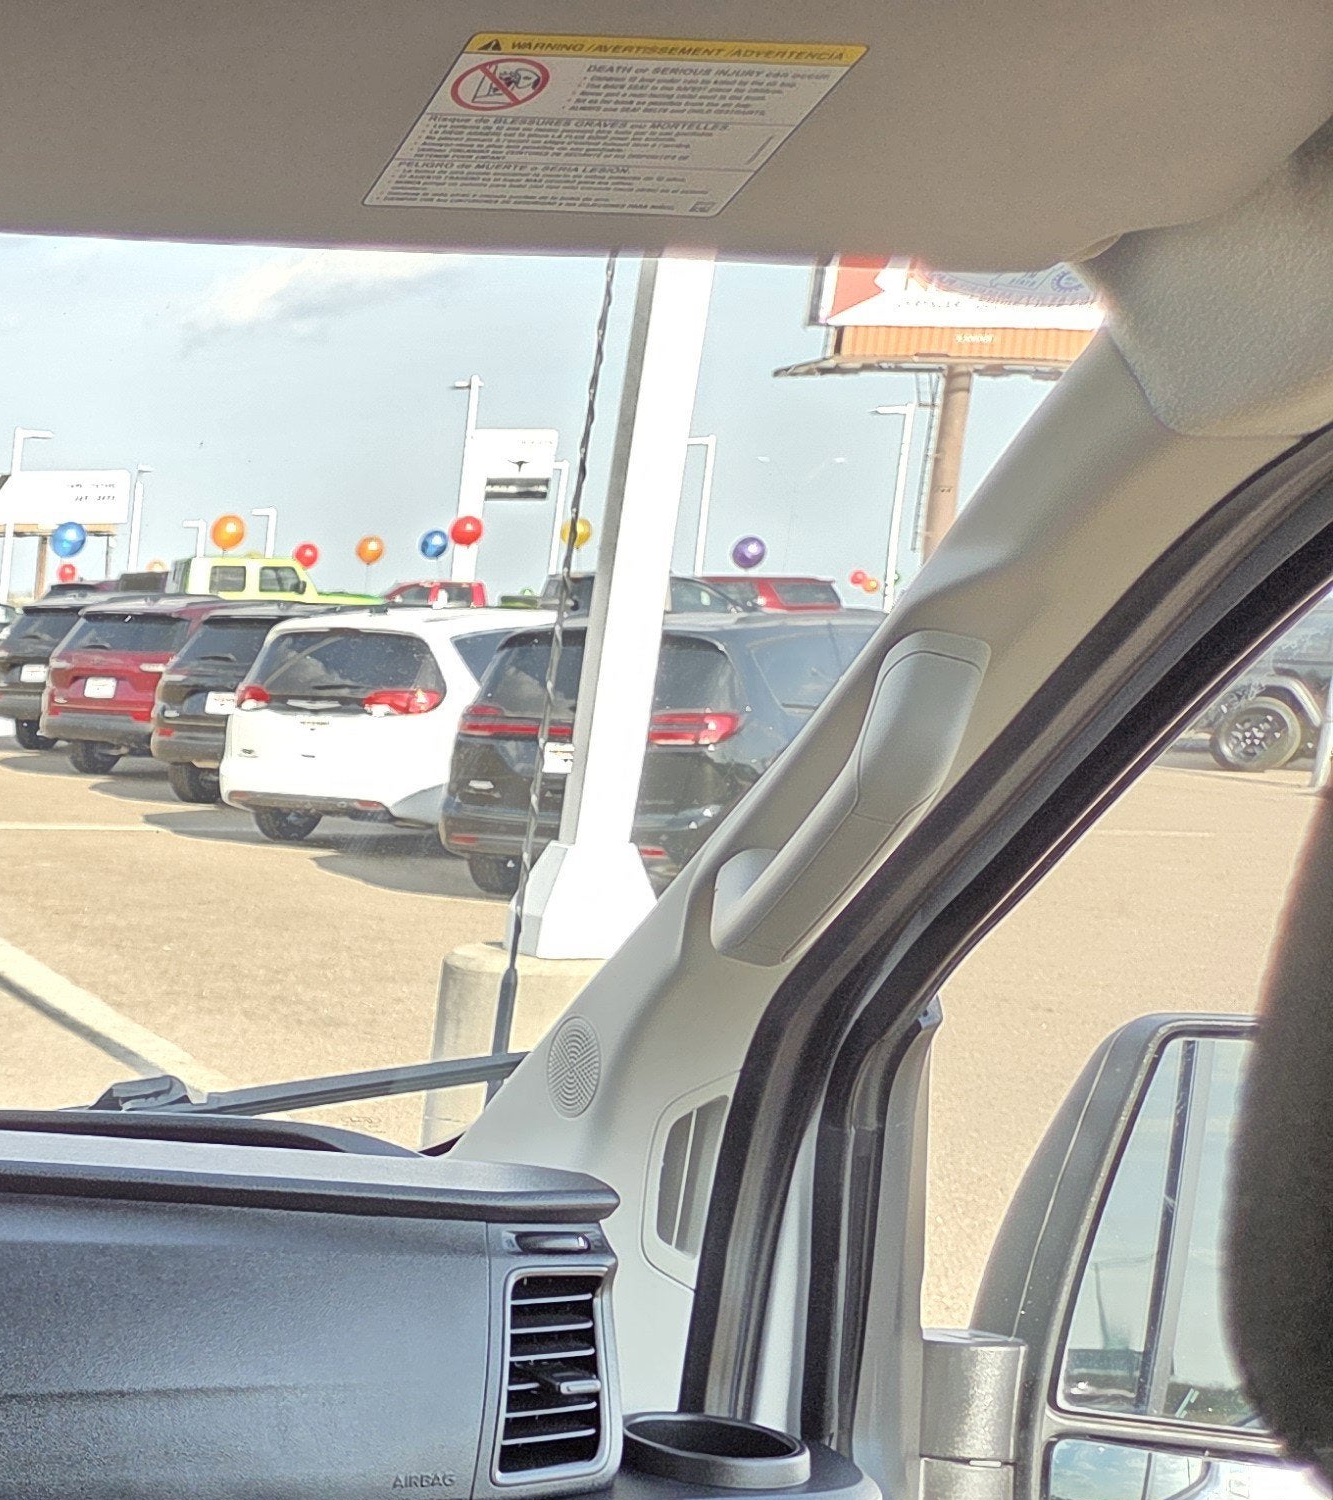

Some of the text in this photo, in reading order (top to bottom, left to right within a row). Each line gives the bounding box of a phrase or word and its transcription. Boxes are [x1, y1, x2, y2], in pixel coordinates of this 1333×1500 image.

[511, 41, 585, 52] WARNING
[586, 64, 632, 74] DEATH
[652, 66, 712, 77] SERIOUS
[714, 68, 766, 78] INJURY
[391, 1473, 456, 1490] AIRBAG
